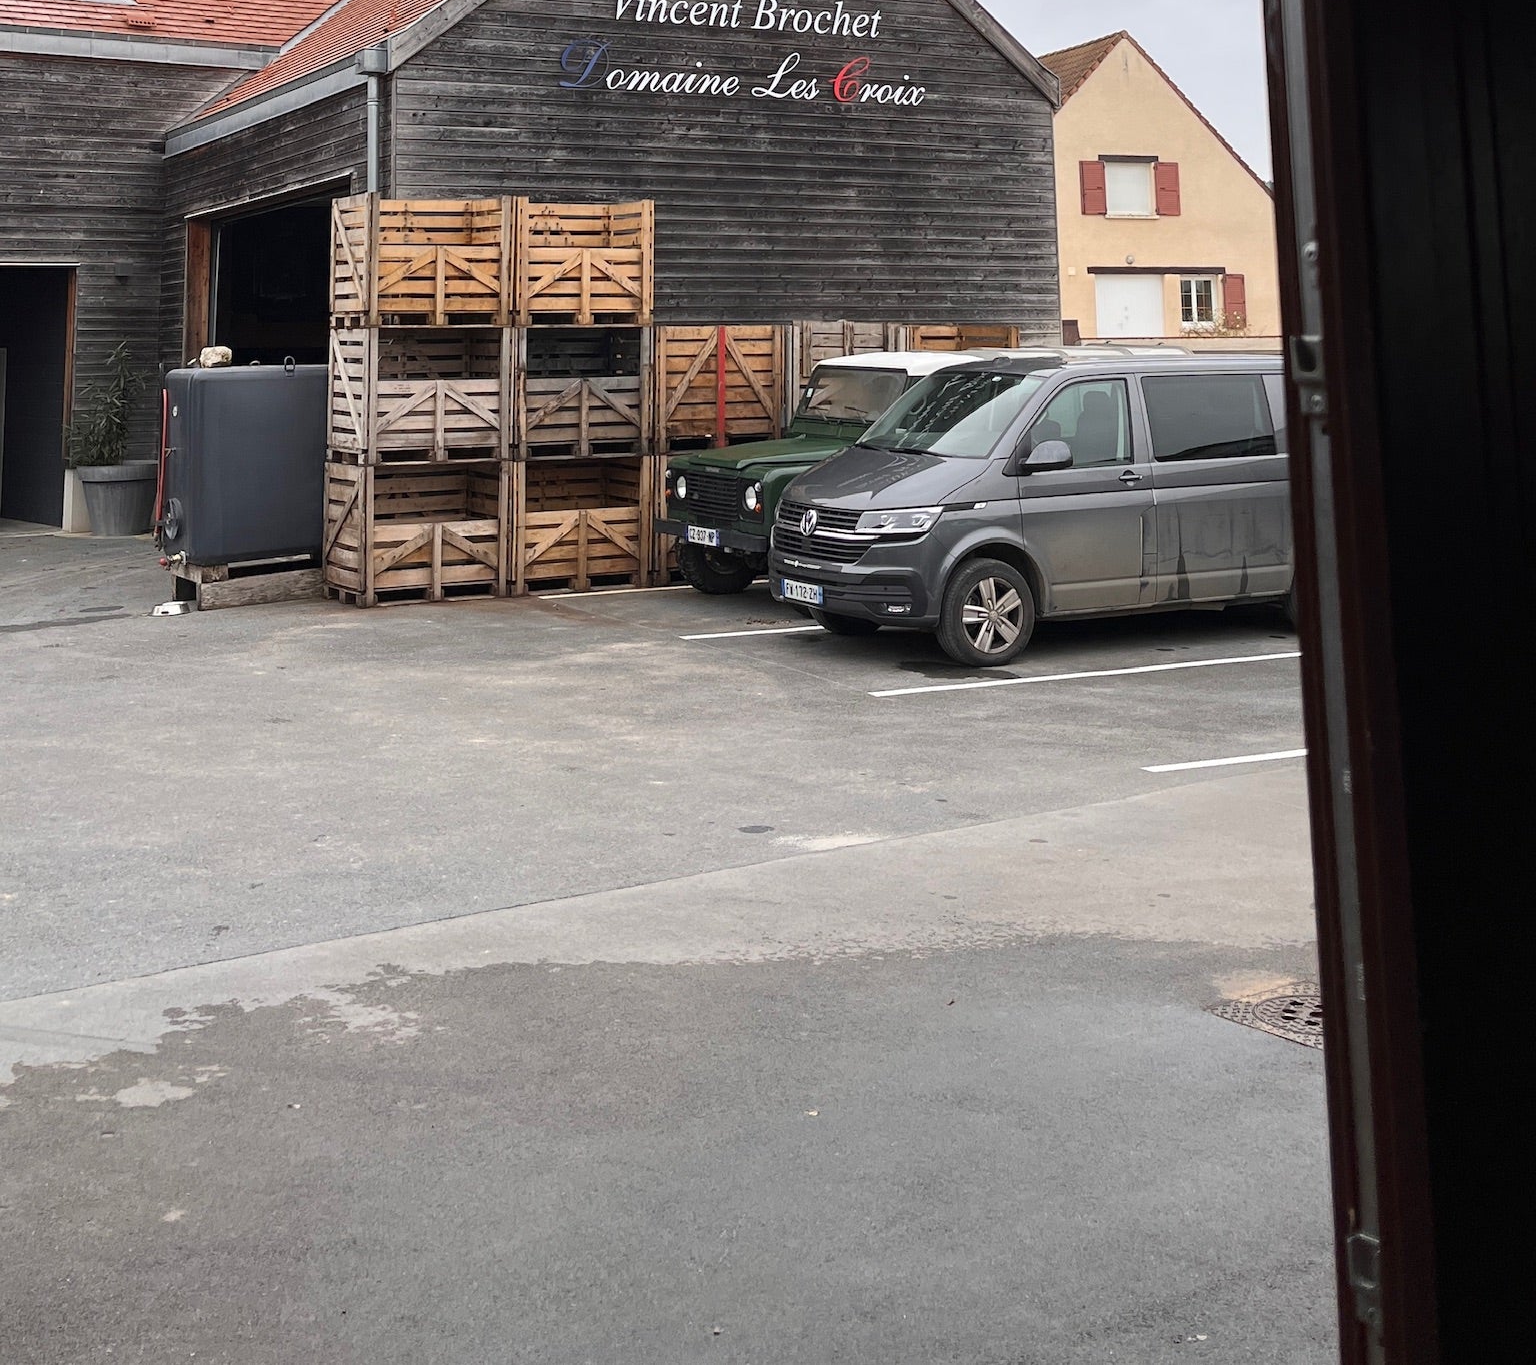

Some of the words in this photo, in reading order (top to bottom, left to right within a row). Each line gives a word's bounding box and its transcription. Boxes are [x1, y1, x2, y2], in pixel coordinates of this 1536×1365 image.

[559, 39, 740, 96] Domaine
[751, 52, 820, 100] Les
[828, 56, 926, 106] Croix
